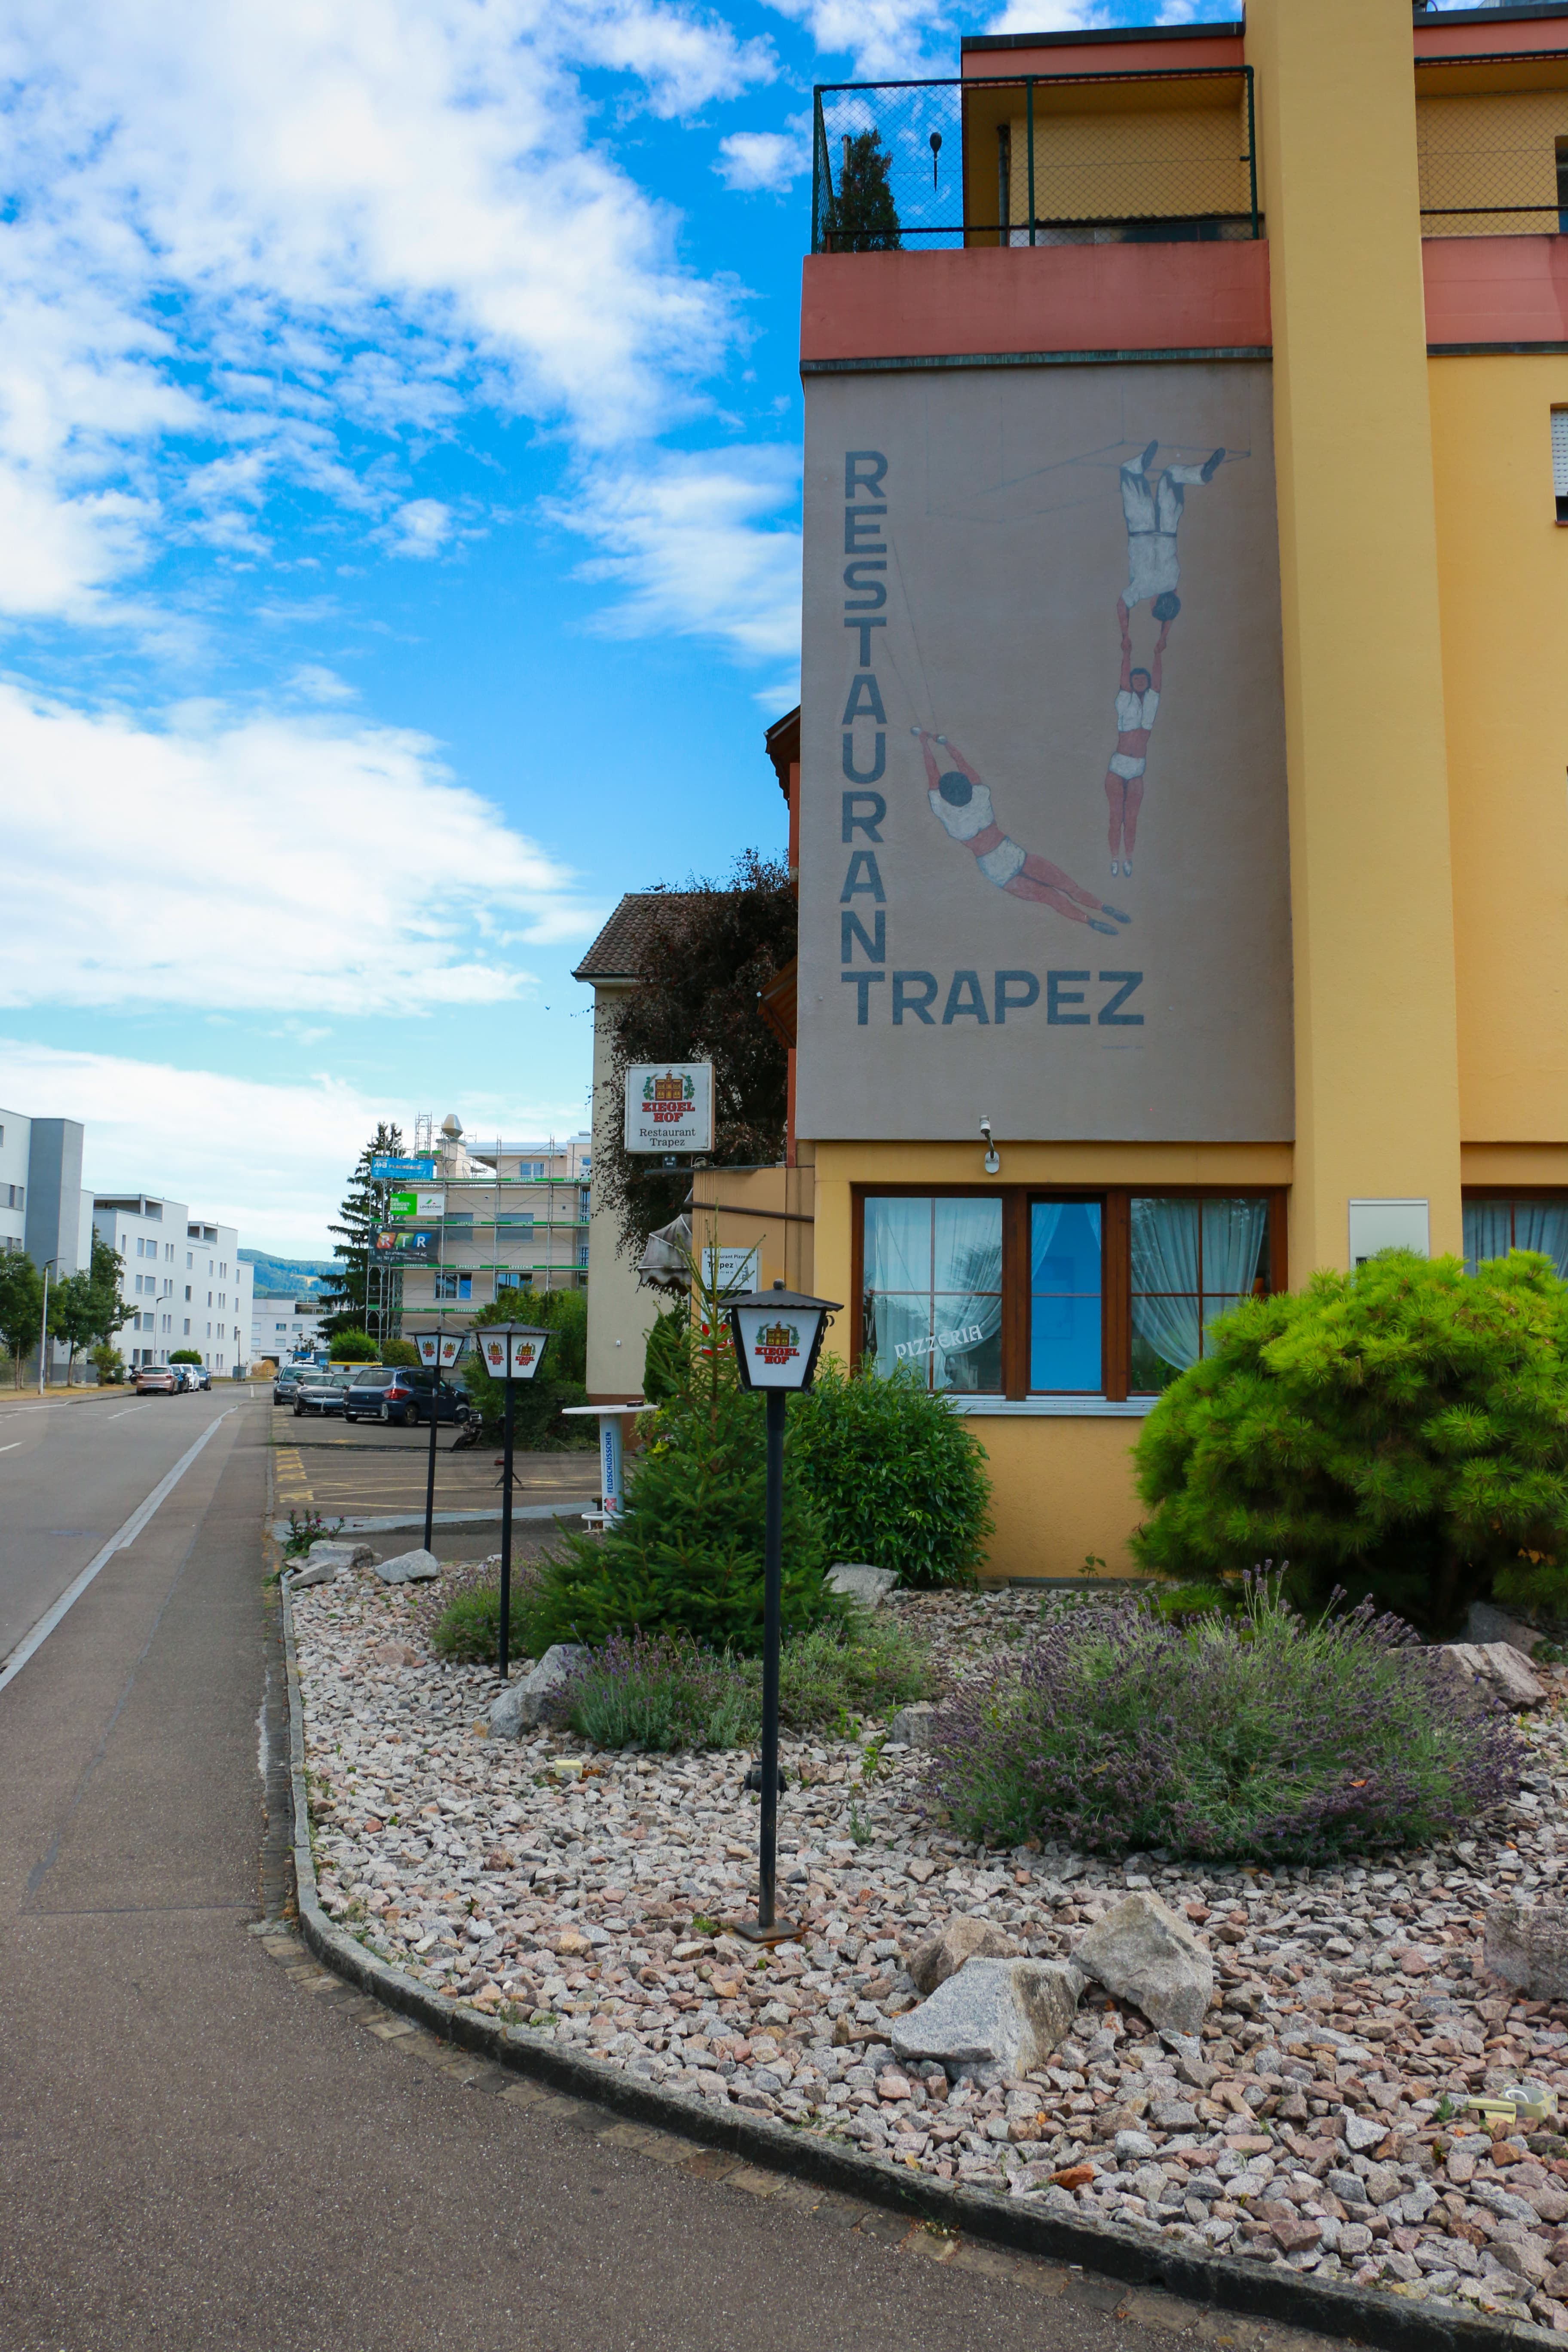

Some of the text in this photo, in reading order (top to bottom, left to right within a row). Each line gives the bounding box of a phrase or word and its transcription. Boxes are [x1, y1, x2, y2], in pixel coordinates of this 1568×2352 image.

[841, 971, 1144, 1025] TRAPEZ
[642, 1102, 695, 1112] ZIEGEL
[653, 1112, 683, 1122] HOF
[639, 1128, 695, 1136] Restaurant
[650, 1138, 685, 1147] Trapez
[707, 1261, 734, 1269] Trpez
[894, 1324, 983, 1360] PIZZERIA
[755, 1347, 800, 1356] ZIEGEL
[764, 1356, 789, 1364] HOF
[605, 1432, 613, 1493] FELDSCHLÖSSCHEN
